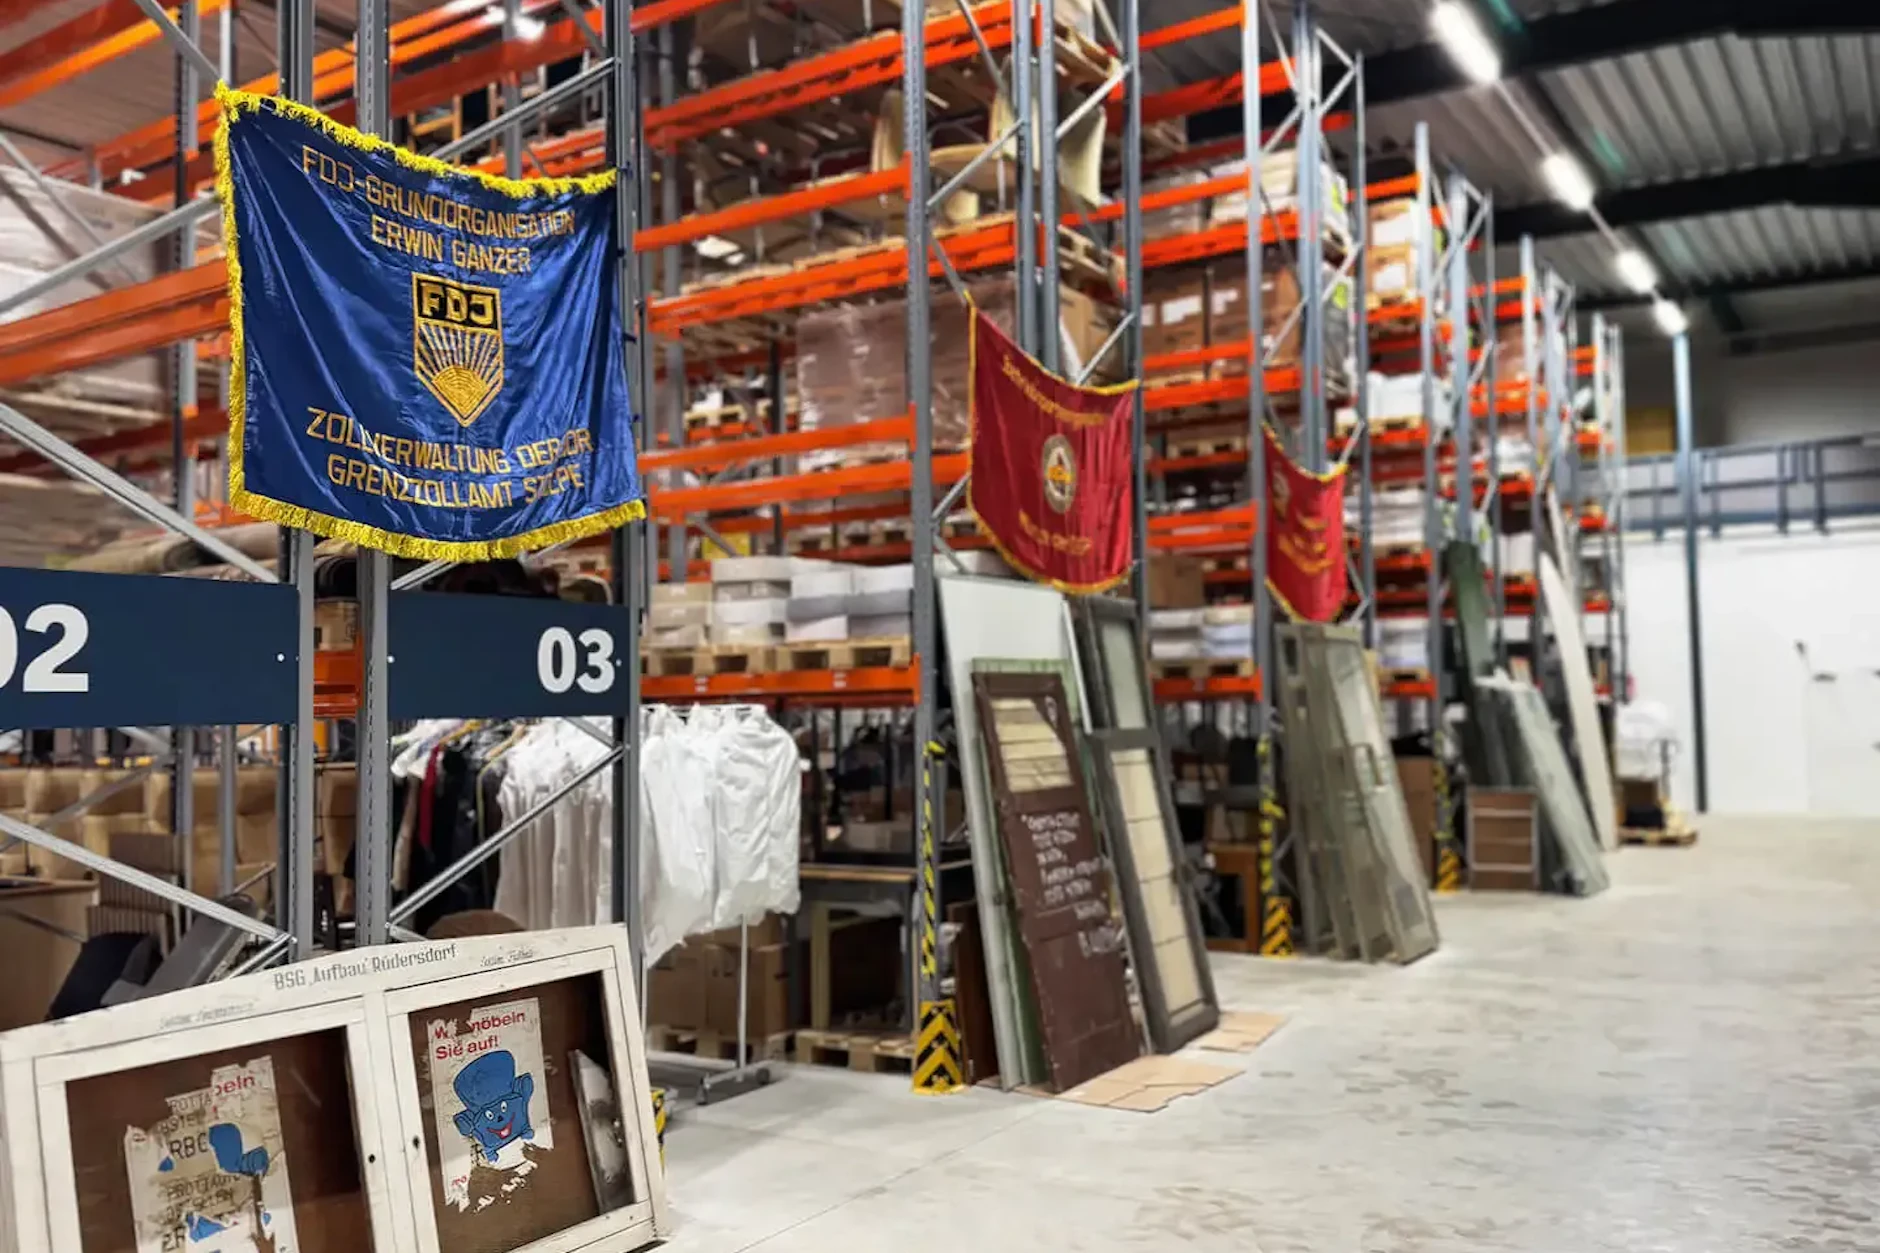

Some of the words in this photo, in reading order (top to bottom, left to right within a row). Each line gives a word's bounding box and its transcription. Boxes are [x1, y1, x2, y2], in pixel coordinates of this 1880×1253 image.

[371, 213, 443, 262] ERWIN
[451, 239, 532, 274] GANZER
[420, 282, 494, 325] FDJ
[306, 406, 511, 474] ZOLLVERWALTUNG
[327, 453, 513, 509] GRENZZOLLAMT
[537, 626, 615, 693] 03
[274, 969, 306, 990] BSG
[436, 1043, 463, 1060] Sie
[467, 1035, 499, 1053] auf!
